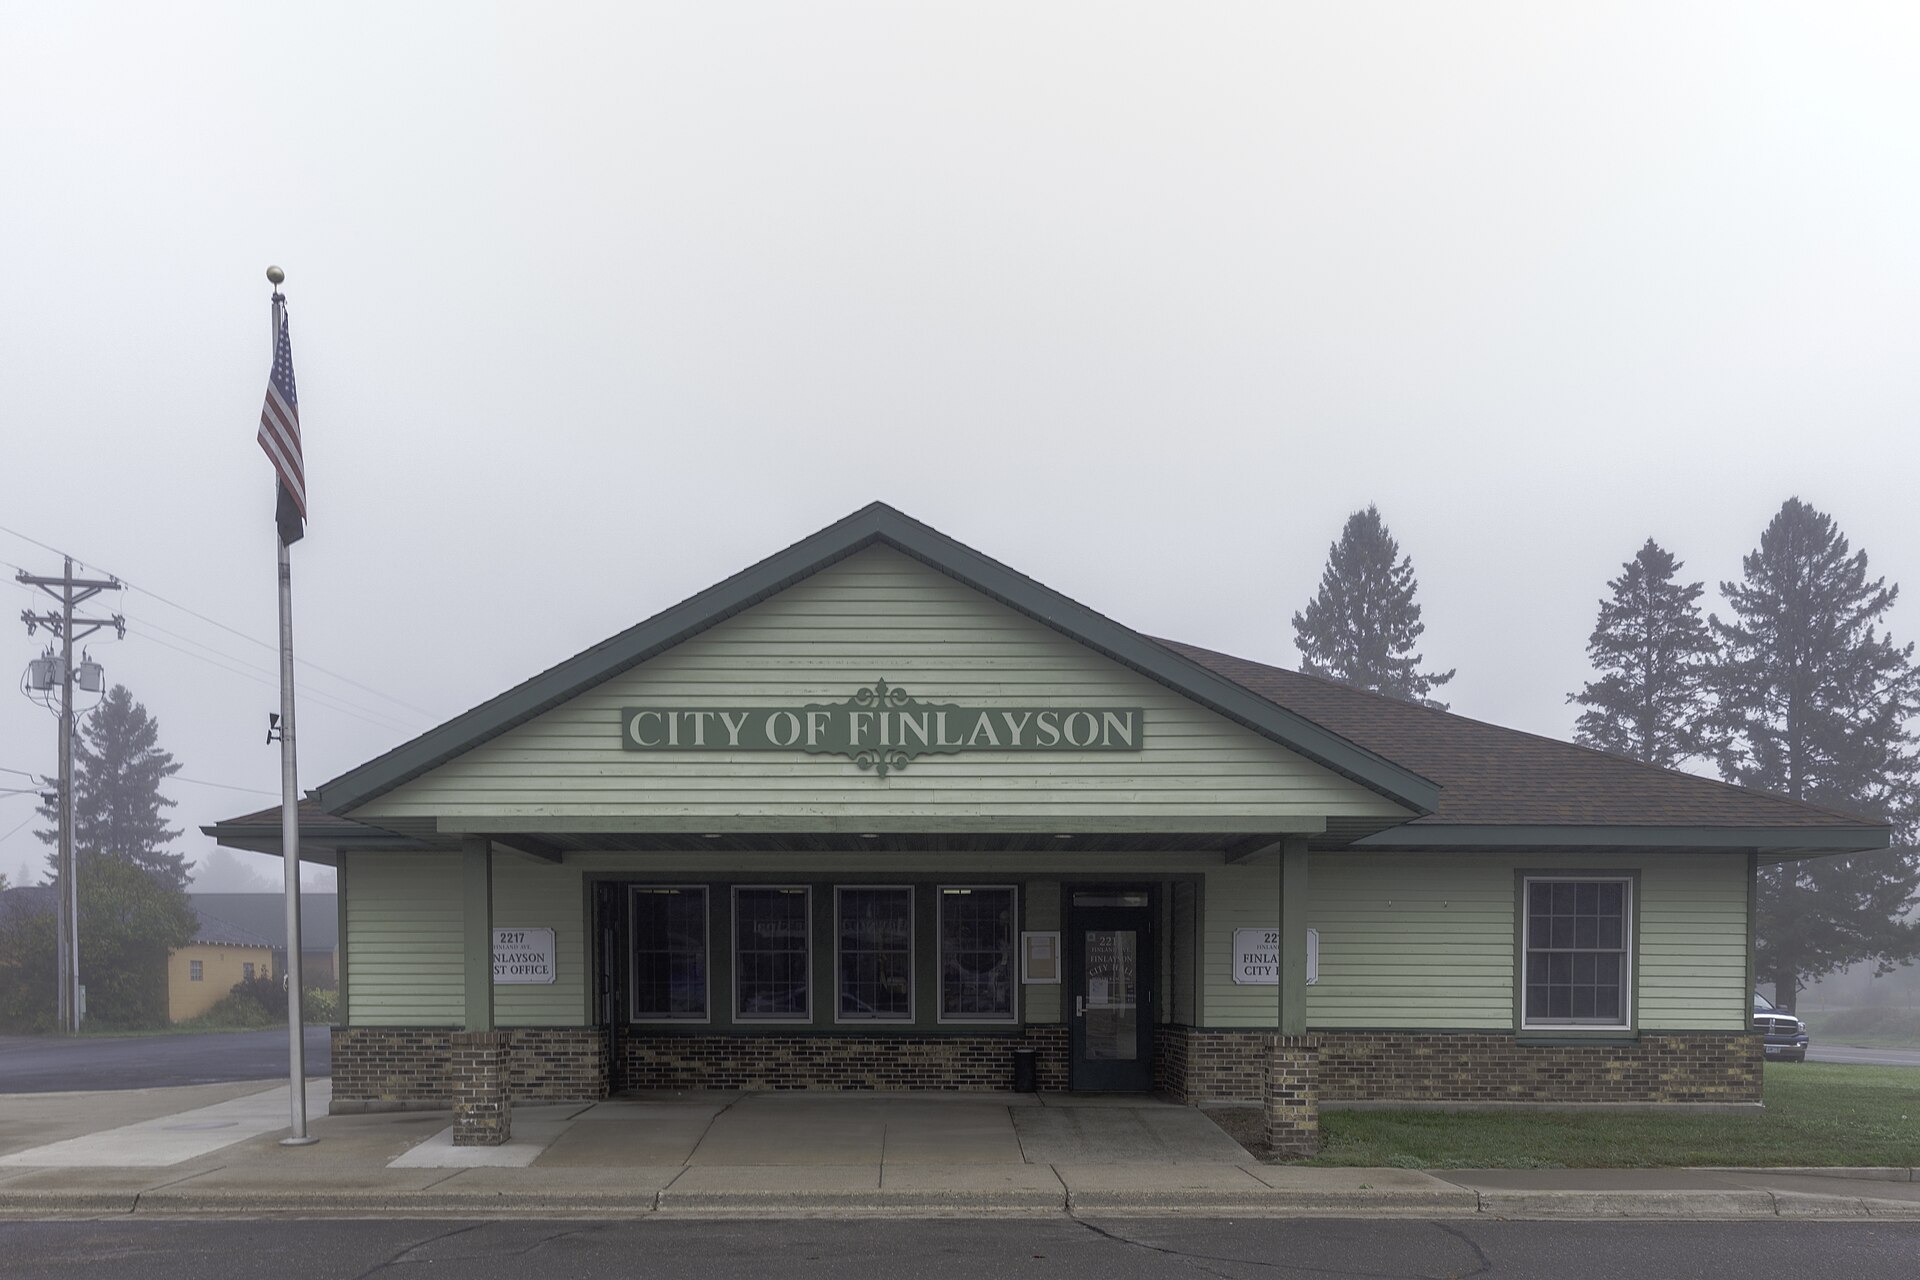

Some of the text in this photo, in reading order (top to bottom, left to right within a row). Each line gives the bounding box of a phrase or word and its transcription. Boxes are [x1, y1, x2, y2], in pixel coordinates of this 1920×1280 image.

[629, 711, 1134, 746] CITY OF FINLAYSON
[500, 933, 525, 943] 2217
[1264, 933, 1279, 943] 22
[494, 953, 545, 963] NLAYSON
[1243, 953, 1279, 963] FINLA
[494, 965, 549, 975] ST OFFICE
[1089, 963, 1108, 977] CITY
[1244, 966, 1272, 976] CITY
